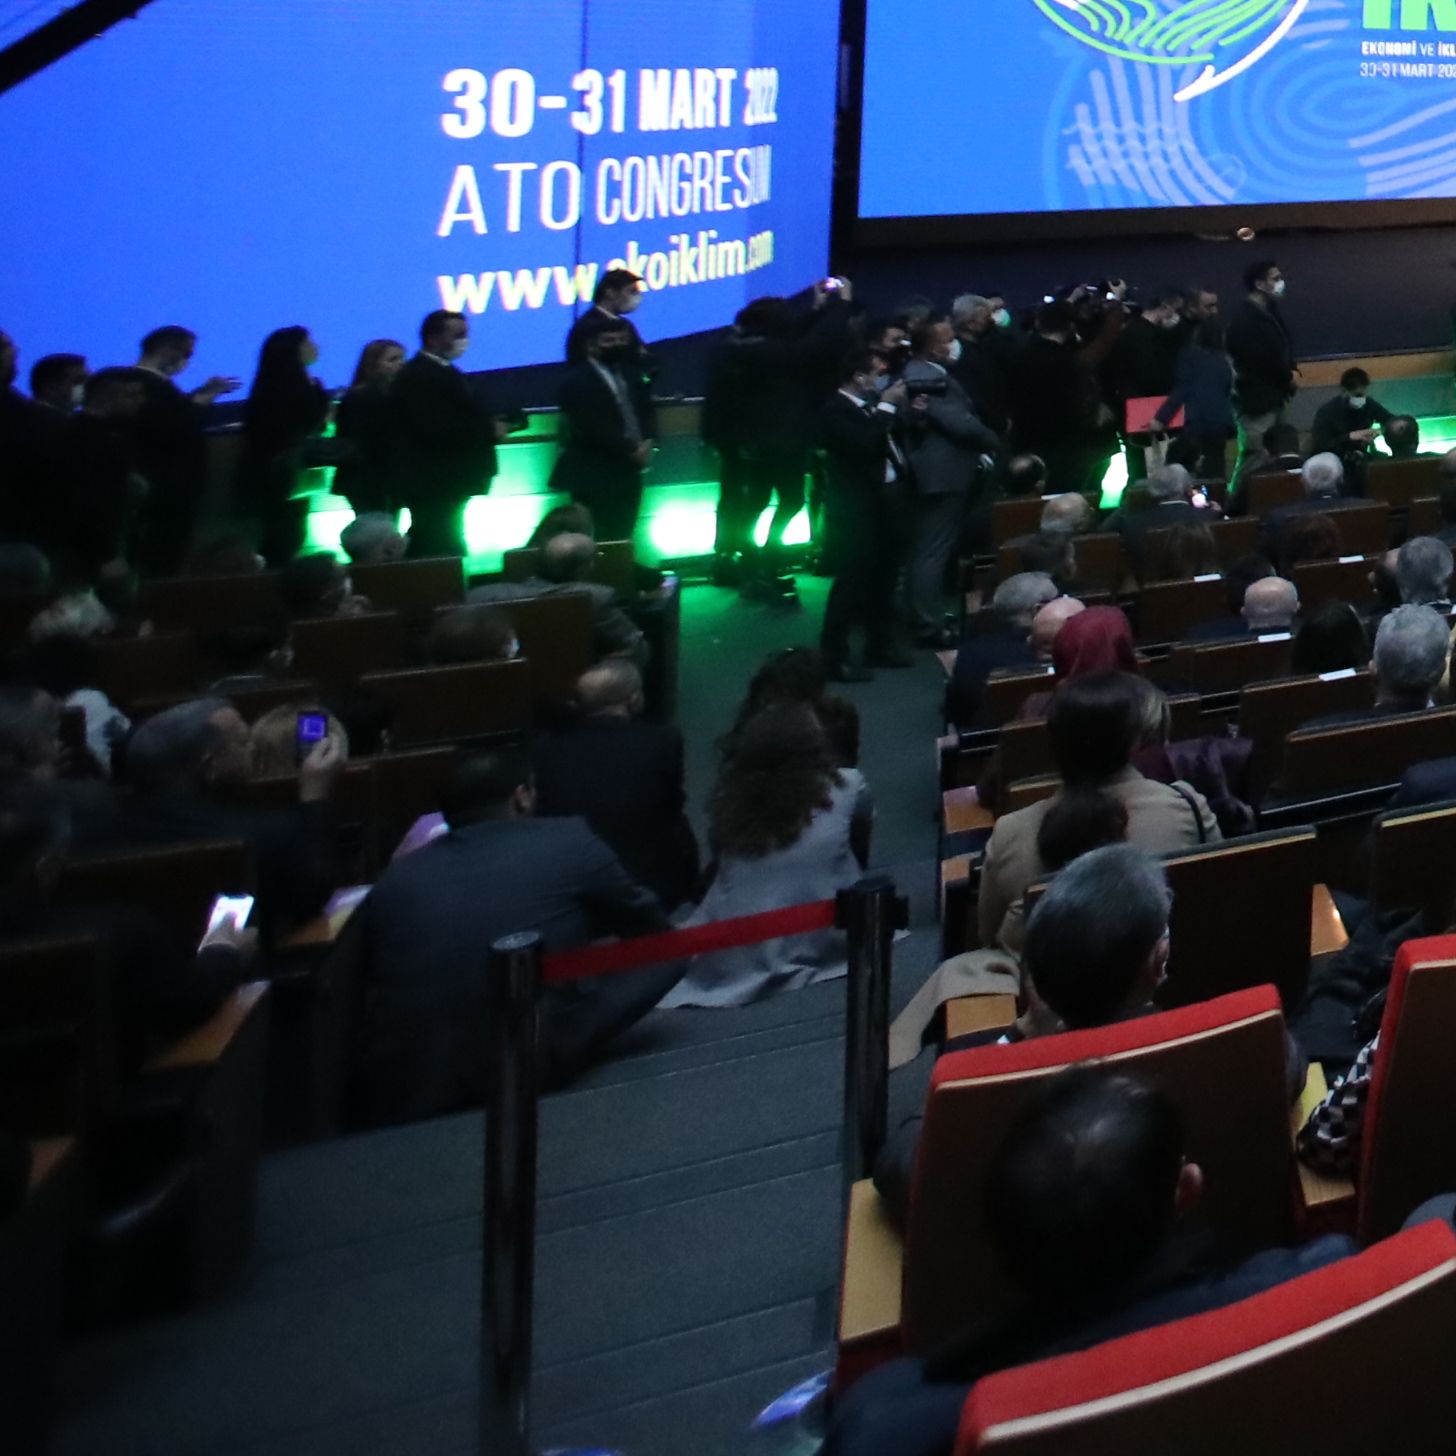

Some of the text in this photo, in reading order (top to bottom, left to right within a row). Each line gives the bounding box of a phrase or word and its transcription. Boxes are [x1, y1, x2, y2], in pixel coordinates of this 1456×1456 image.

[1361, 40, 1417, 56] EKONOMİ
[1420, 43, 1435, 56] VE
[1400, 63, 1434, 78] MART
[441, 68, 627, 139] 30-31
[638, 67, 737, 132] MART
[437, 160, 582, 237] ATO
